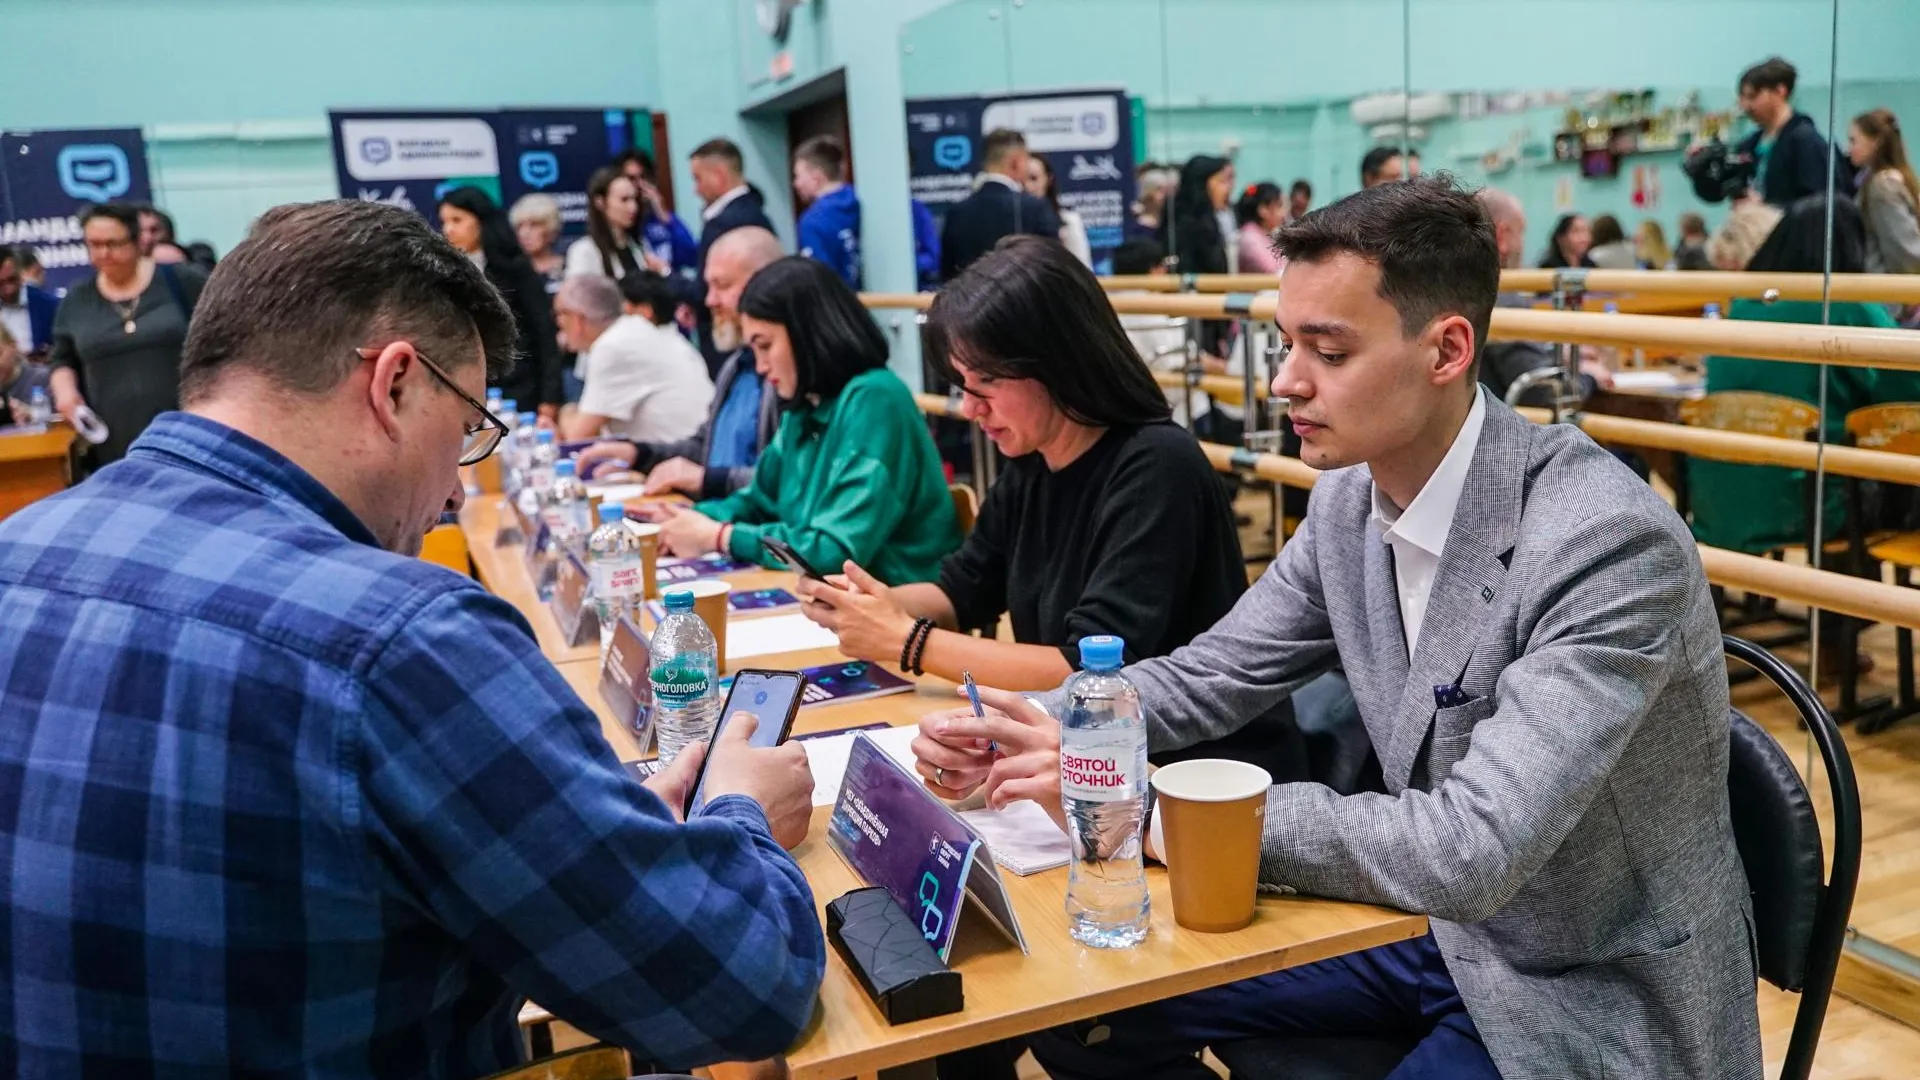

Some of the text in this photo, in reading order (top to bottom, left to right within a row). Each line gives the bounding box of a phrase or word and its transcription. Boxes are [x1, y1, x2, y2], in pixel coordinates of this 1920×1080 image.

[651, 680, 707, 693] ЕРНОГОЛОВКА
[1062, 752, 1115, 772] СВЯТОЙ
[1062, 767, 1125, 787] СТОЧНИК
